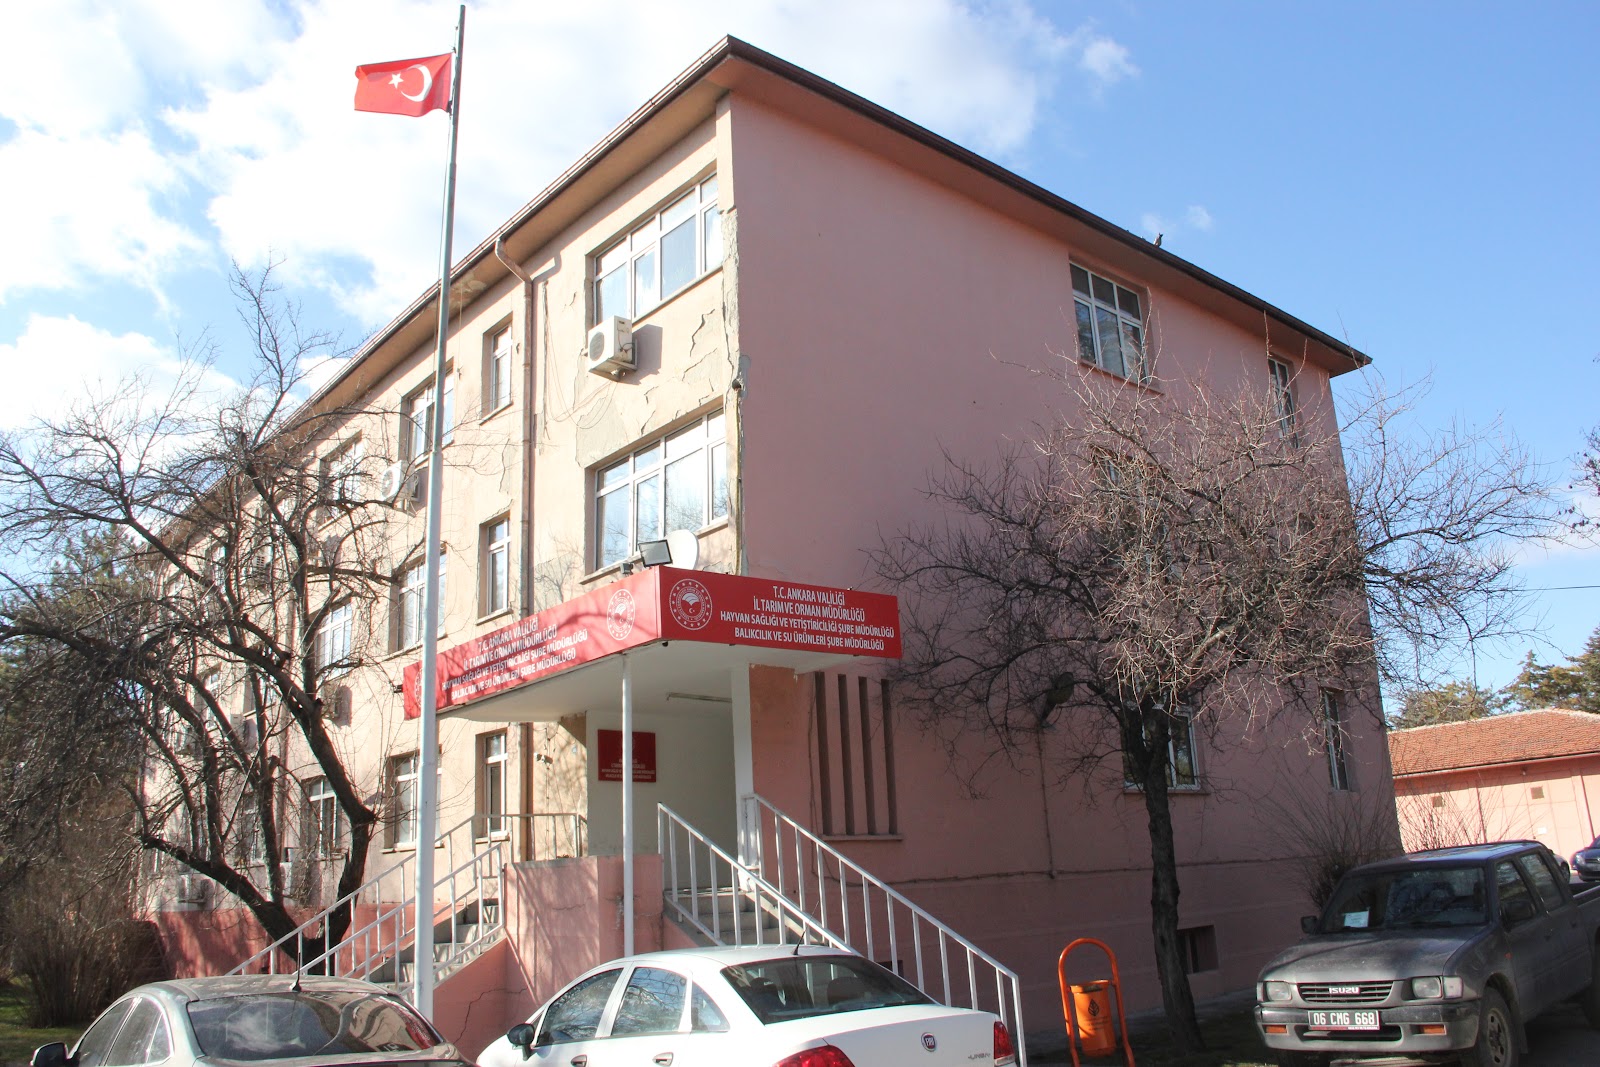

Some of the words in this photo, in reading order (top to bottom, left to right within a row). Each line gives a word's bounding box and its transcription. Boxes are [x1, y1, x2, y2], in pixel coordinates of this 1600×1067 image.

[754, 596, 760, 610] İL
[761, 599, 783, 612] TARIM
[784, 602, 793, 614] VE
[795, 603, 821, 617] ORMAN
[822, 604, 865, 622] MÜDÜRLÜĞÜ
[773, 586, 786, 598] T.C.
[787, 587, 815, 602] ANKARA
[817, 590, 845, 605] VALİLİĞİ
[489, 631, 513, 648] ANKARA
[513, 617, 538, 639] VALİLİĞİ
[721, 611, 750, 623] HAYVAN
[751, 613, 778, 626] SAĞLIĞI
[779, 617, 788, 627] VE
[790, 617, 837, 632] YETİŞTİRİCİLİĞİ
[838, 624, 854, 635] ŞUBE
[855, 624, 894, 638] MÜDÜRLÜĞÜ
[495, 644, 517, 660] ORMAN
[517, 624, 557, 652] MÜDÜRLÜĞÜ
[531, 646, 546, 661] ŞUBE
[547, 629, 588, 653] MÜDÜRLÜĞÜ
[735, 628, 772, 641] BALIKCILIK
[773, 631, 782, 641] VE
[783, 632, 792, 642] SU
[794, 631, 826, 645] ÜRÜNLERİ
[827, 637, 843, 648] ŞUBE
[845, 637, 884, 650] MÜDÜRLÜĞÜ
[521, 662, 536, 677] ŞUBE
[536, 648, 576, 671] MÜDÜRLÜĞÜ
[1313, 1013, 1326, 1024] 06
[1330, 1013, 1349, 1024] CMG
[1355, 1013, 1374, 1024] 668
